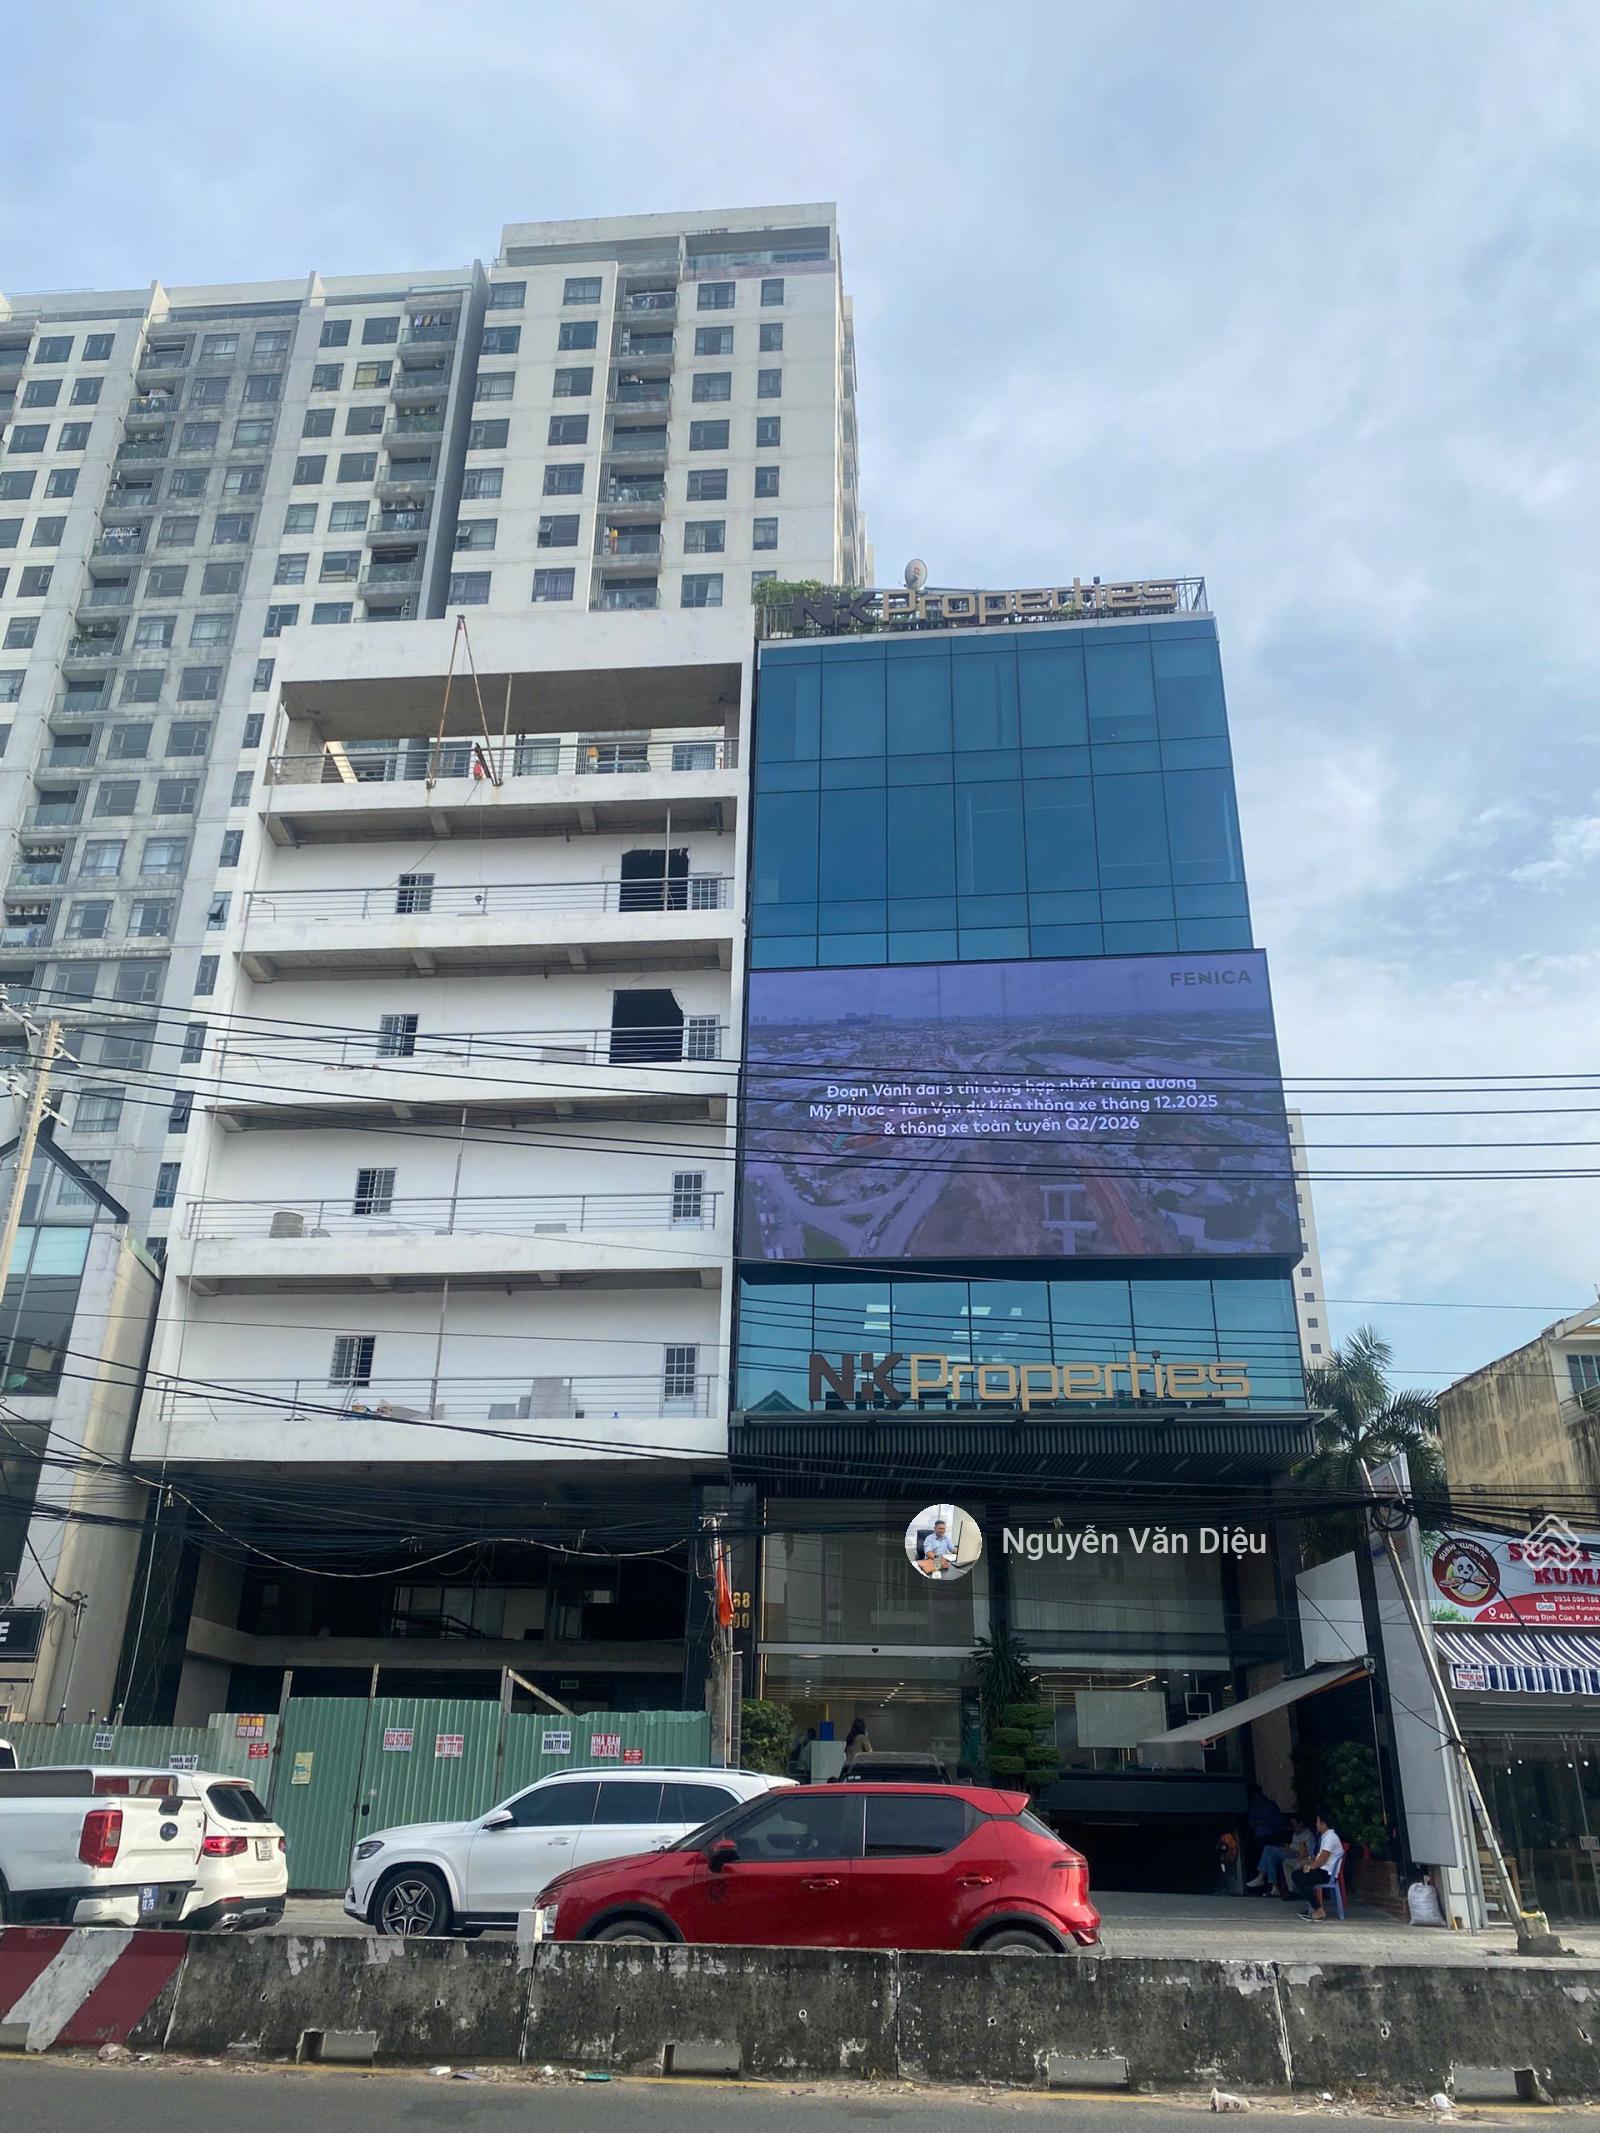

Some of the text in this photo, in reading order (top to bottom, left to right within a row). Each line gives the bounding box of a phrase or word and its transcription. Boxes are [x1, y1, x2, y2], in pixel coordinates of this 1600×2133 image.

[1170, 970, 1252, 986] FENICA
[827, 1085, 868, 1101] Đoạn
[872, 1083, 911, 1097] Vành
[945, 1081, 953, 1094] 3
[957, 1081, 979, 1094] thi
[983, 1081, 1021, 1096] công
[1025, 1080, 1055, 1096] hợp
[1060, 1078, 1097, 1092] nhất
[1102, 1078, 1141, 1094] cùng
[810, 1105, 833, 1120] Mỹ
[837, 1102, 885, 1117] Phước
[899, 1102, 928, 1115] Tân
[931, 1101, 961, 1118] Vạn
[966, 1100, 987, 1117] dự
[990, 1098, 1022, 1109] kiến
[1025, 1098, 1074, 1114] thông
[1079, 1101, 1097, 1111] xe
[1101, 1097, 1150, 1112] tháng
[1154, 1095, 1218, 1109] 12.2025
[884, 1117, 1139, 1136] & thông xe toàn tuyến Q2/2026
[1534, 1568, 1600, 1585] KUM
